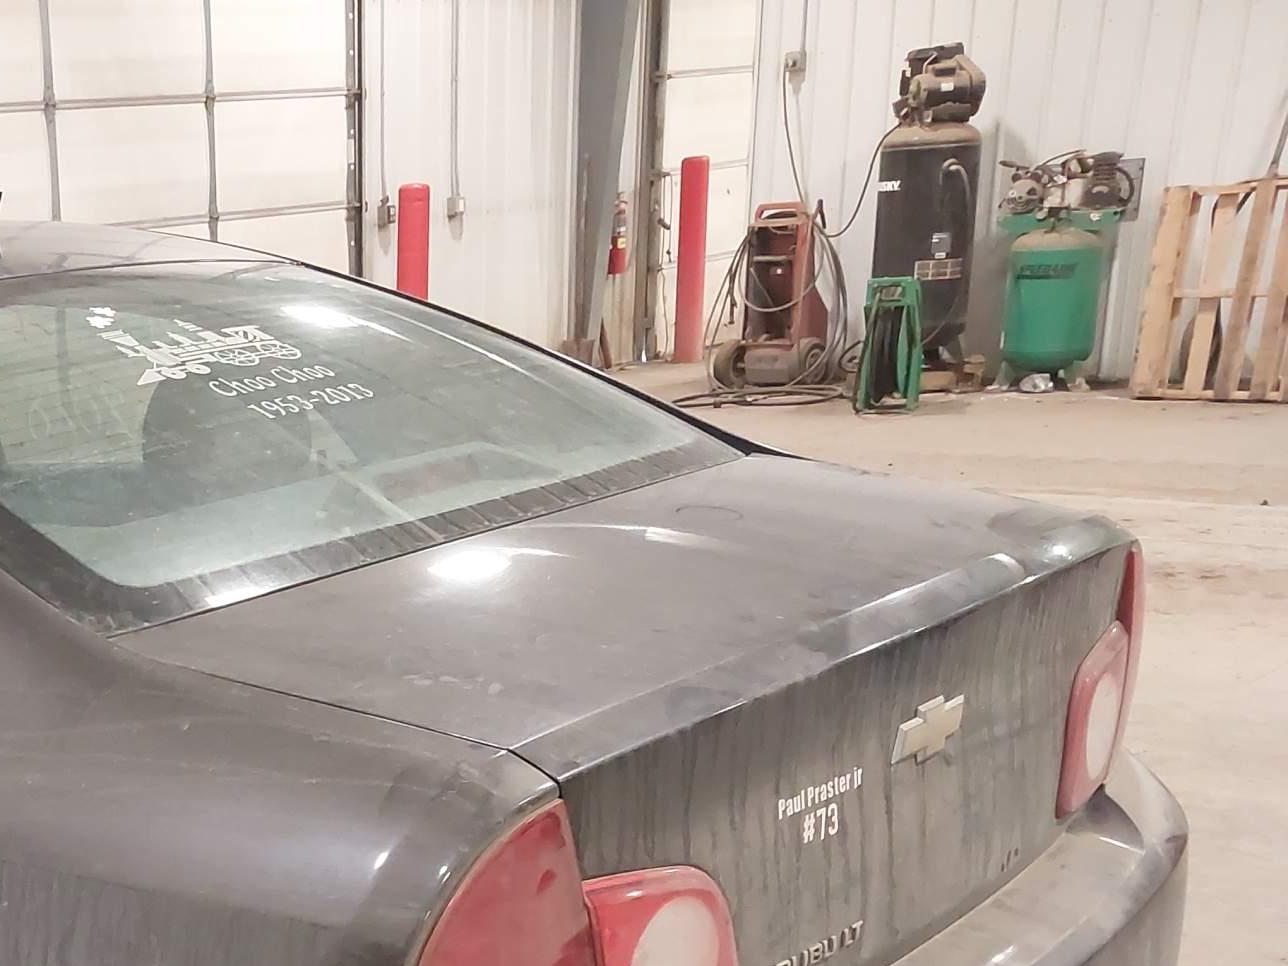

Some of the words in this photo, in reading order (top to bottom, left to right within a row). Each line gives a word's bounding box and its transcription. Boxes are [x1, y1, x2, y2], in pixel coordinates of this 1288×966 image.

[208, 376, 277, 396] Choo
[270, 365, 336, 383] Choo
[247, 383, 375, 418] 1953-2013
[778, 789, 806, 820] Paul
[807, 773, 852, 808] Praster
[853, 766, 863, 789] jr
[803, 802, 839, 844] #73
[840, 920, 864, 949] LT
